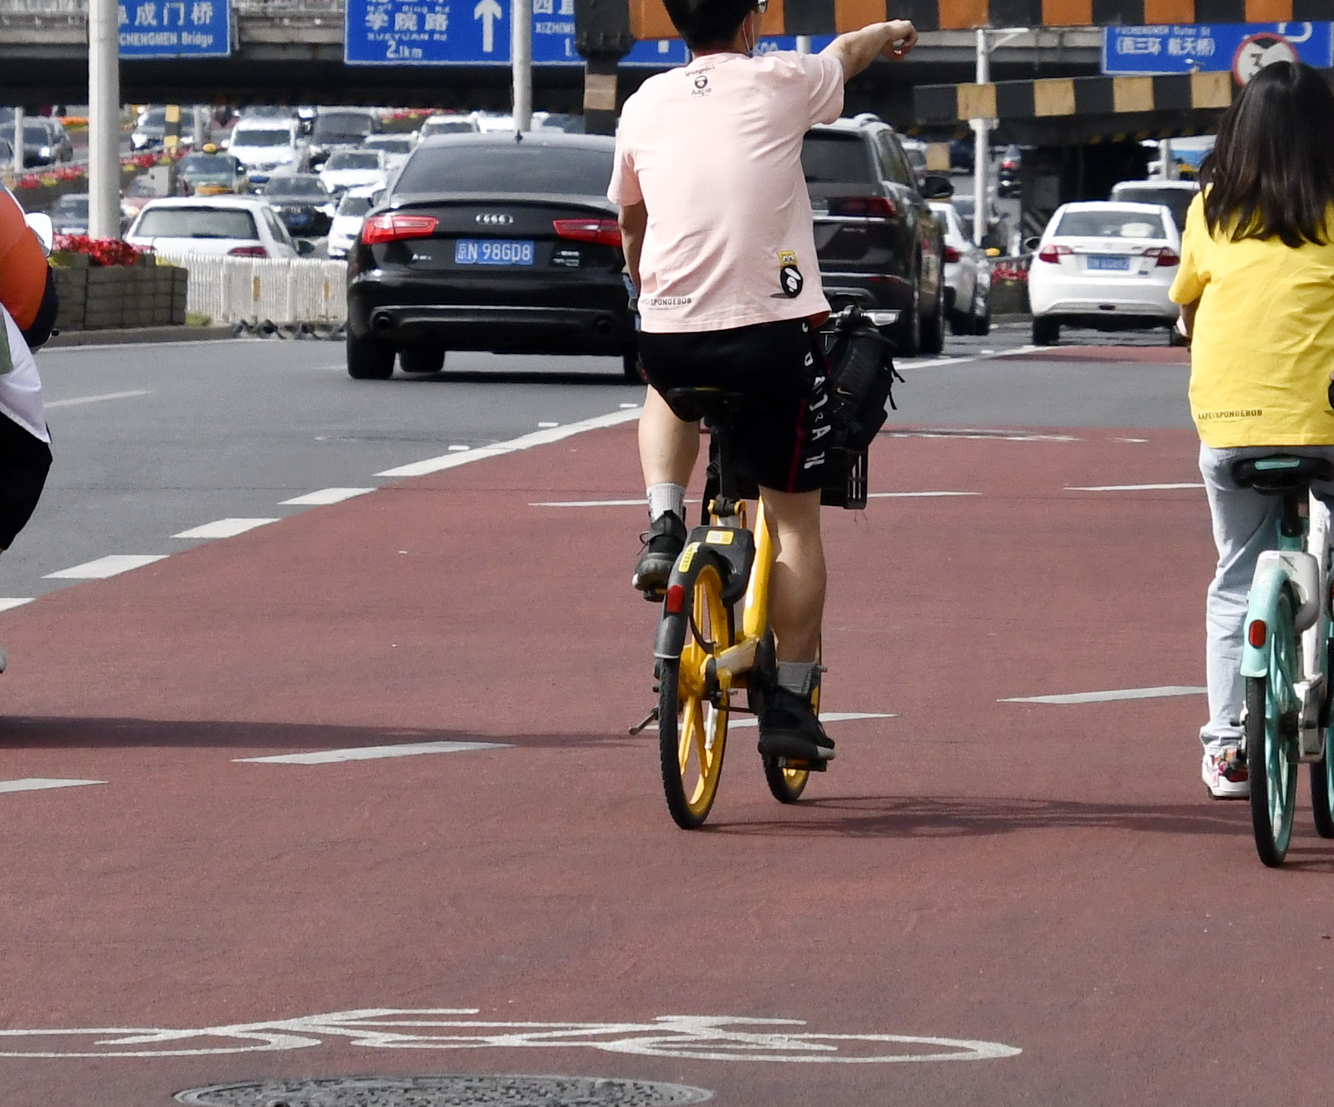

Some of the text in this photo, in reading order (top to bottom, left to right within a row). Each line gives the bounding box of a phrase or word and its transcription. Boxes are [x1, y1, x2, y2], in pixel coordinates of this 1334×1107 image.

[365, 12, 449, 31] 学院路
[182, 31, 214, 48] Bridge
